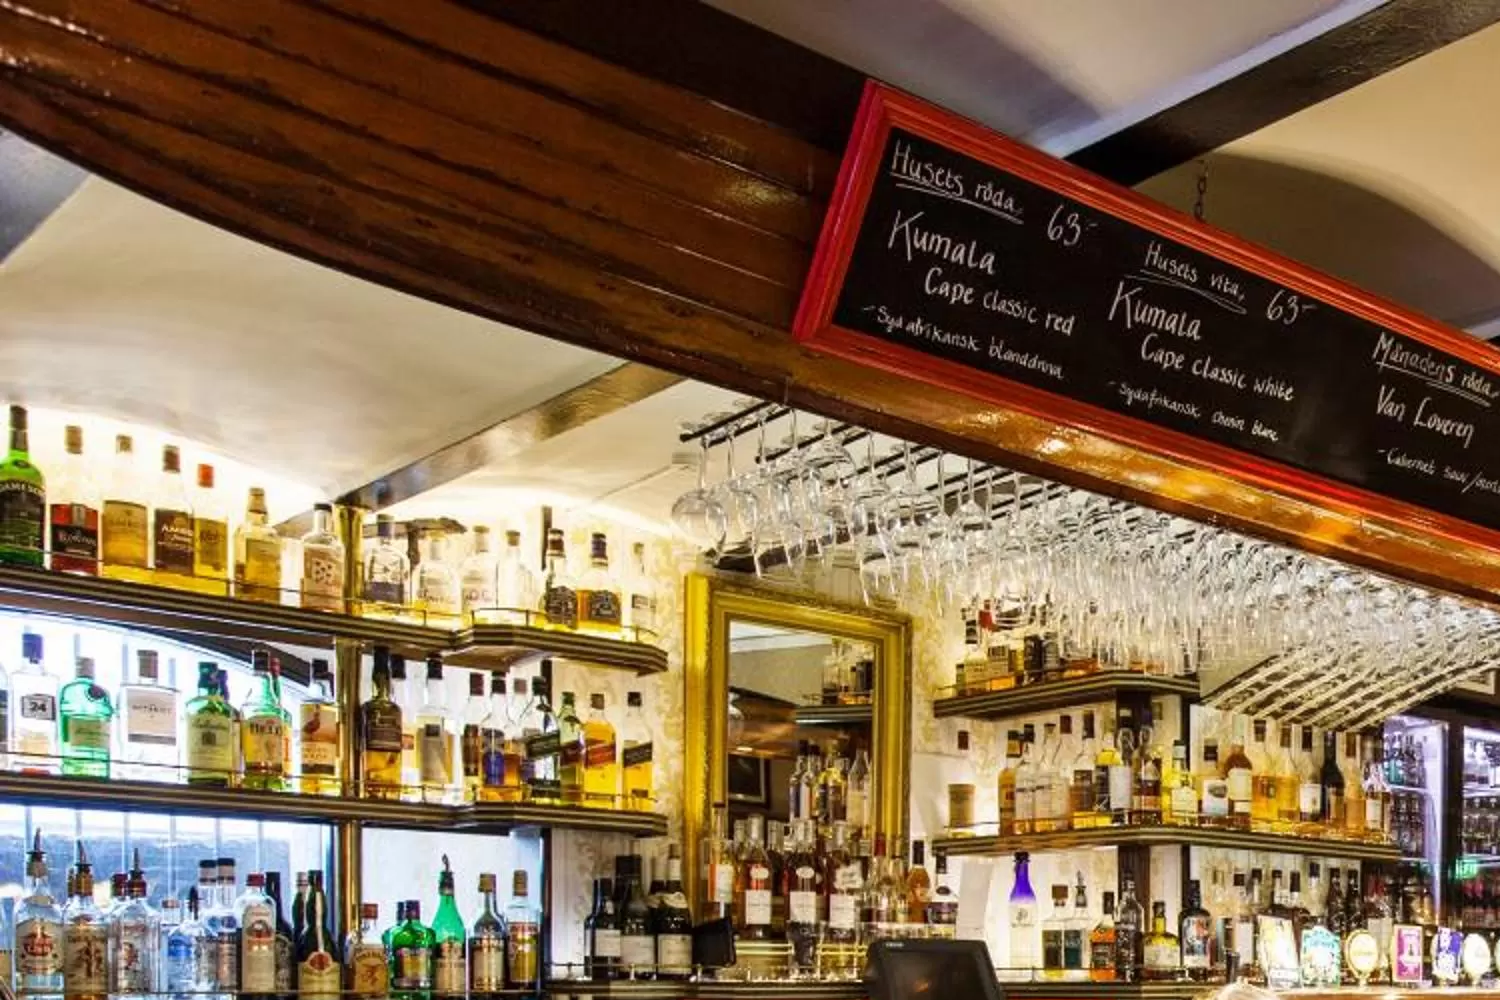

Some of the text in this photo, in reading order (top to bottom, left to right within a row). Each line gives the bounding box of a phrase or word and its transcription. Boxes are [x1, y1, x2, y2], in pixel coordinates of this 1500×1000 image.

[891, 139, 963, 197] Husets
[888, 210, 996, 275] Kumala
[1143, 240, 1199, 284] Husets
[925, 266, 1075, 337] Cape classic red
[1108, 280, 1202, 341] Kumala
[1141, 332, 1295, 402] Cape classic white
[1376, 384, 1475, 449] Van Loveren
[29, 700, 47, 713] 24
